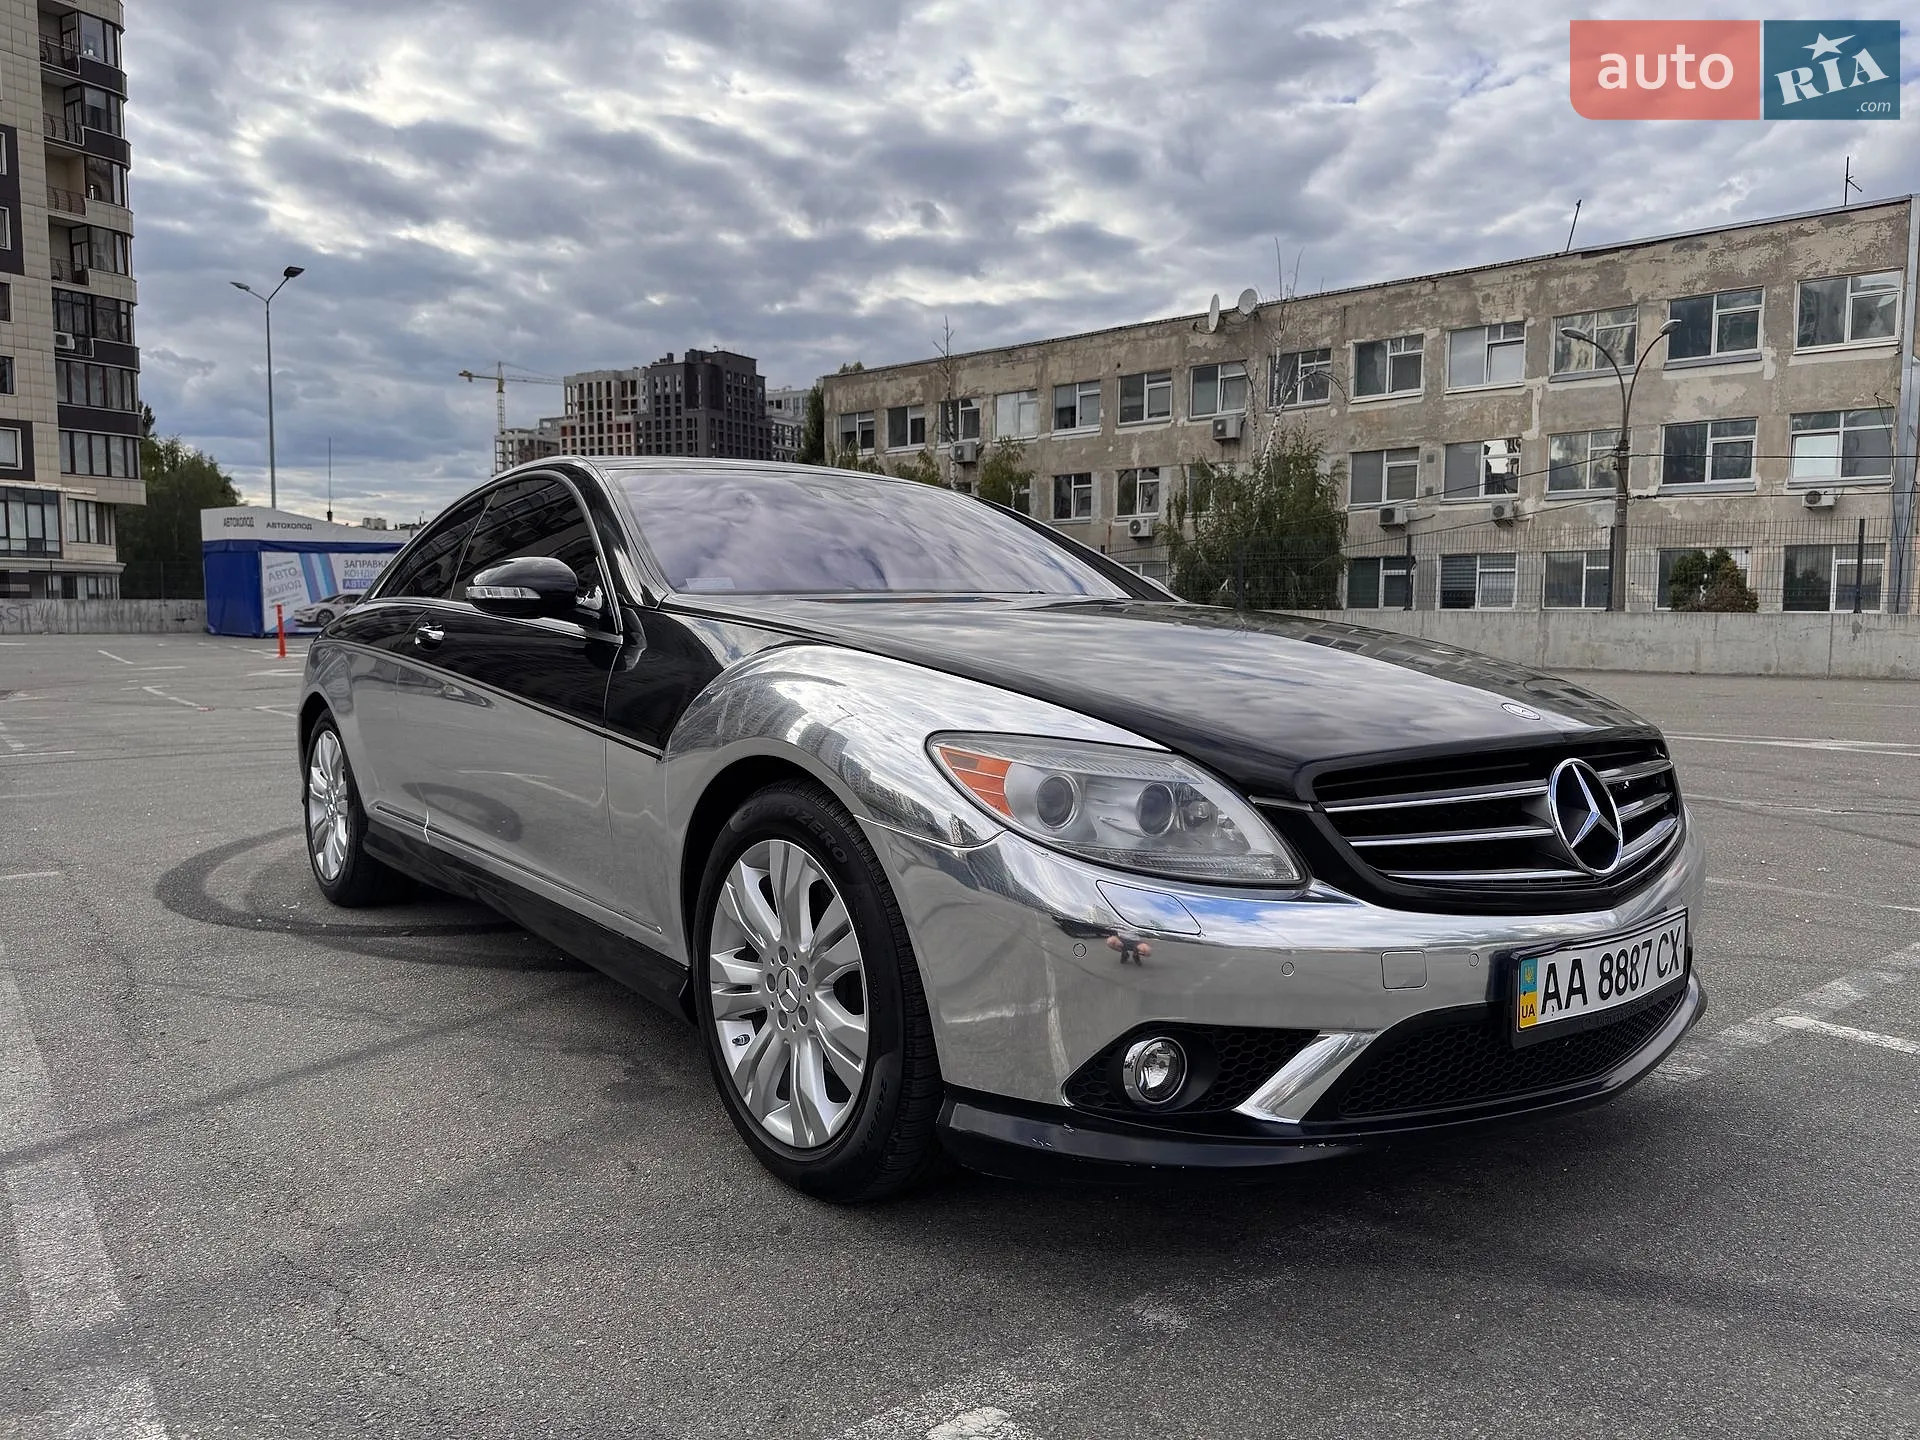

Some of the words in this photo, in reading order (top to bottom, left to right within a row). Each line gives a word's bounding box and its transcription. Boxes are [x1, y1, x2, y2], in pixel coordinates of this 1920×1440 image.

[266, 521, 313, 531] АВТОХОЛОД
[268, 566, 298, 582] АВТО
[1540, 957, 1588, 1016] AA
[1598, 938, 1653, 1001] 8887
[1656, 926, 1682, 979] CX
[1521, 1003, 1536, 1019] UA
